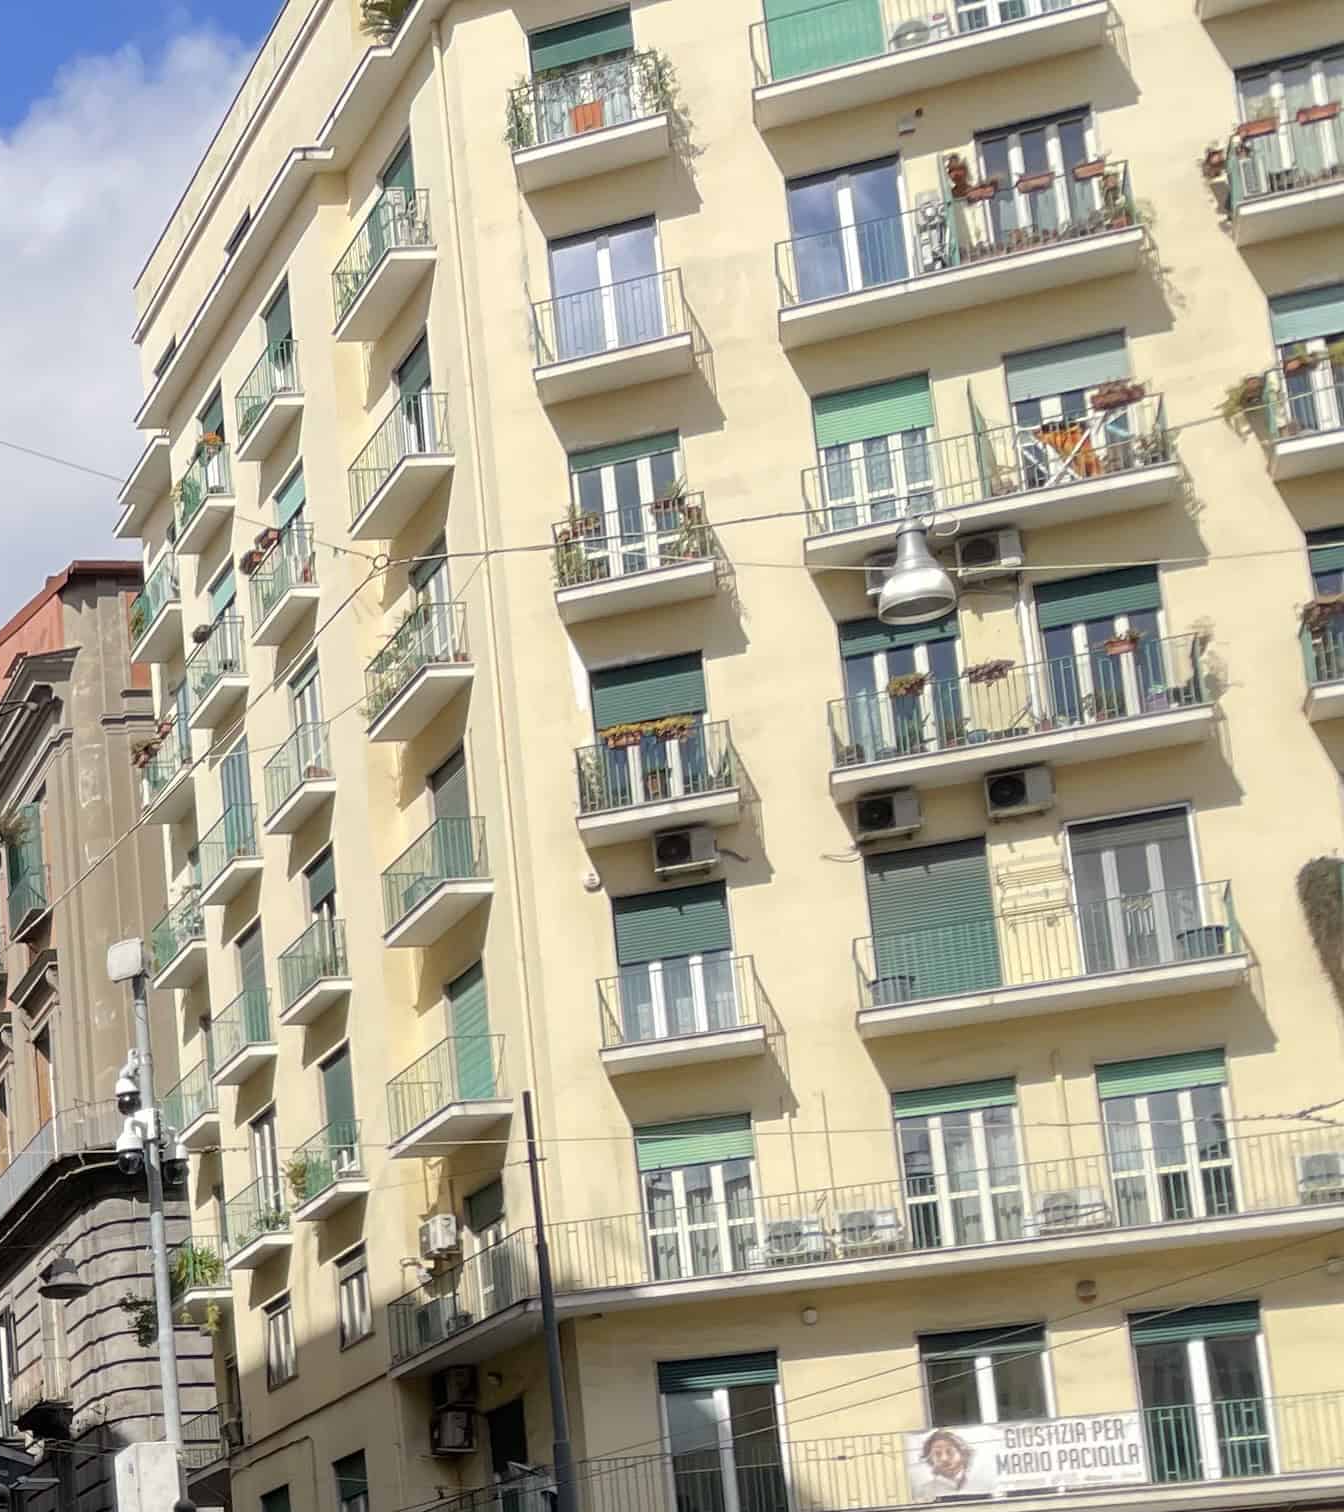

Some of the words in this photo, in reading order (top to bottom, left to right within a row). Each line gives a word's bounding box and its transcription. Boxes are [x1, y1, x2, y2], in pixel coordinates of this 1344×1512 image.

[1004, 1422, 1087, 1449] GIUSTIZIA
[1092, 1418, 1125, 1442] PER
[996, 1450, 1052, 1475] MARIO
[1057, 1443, 1140, 1471] PACIOLLA
